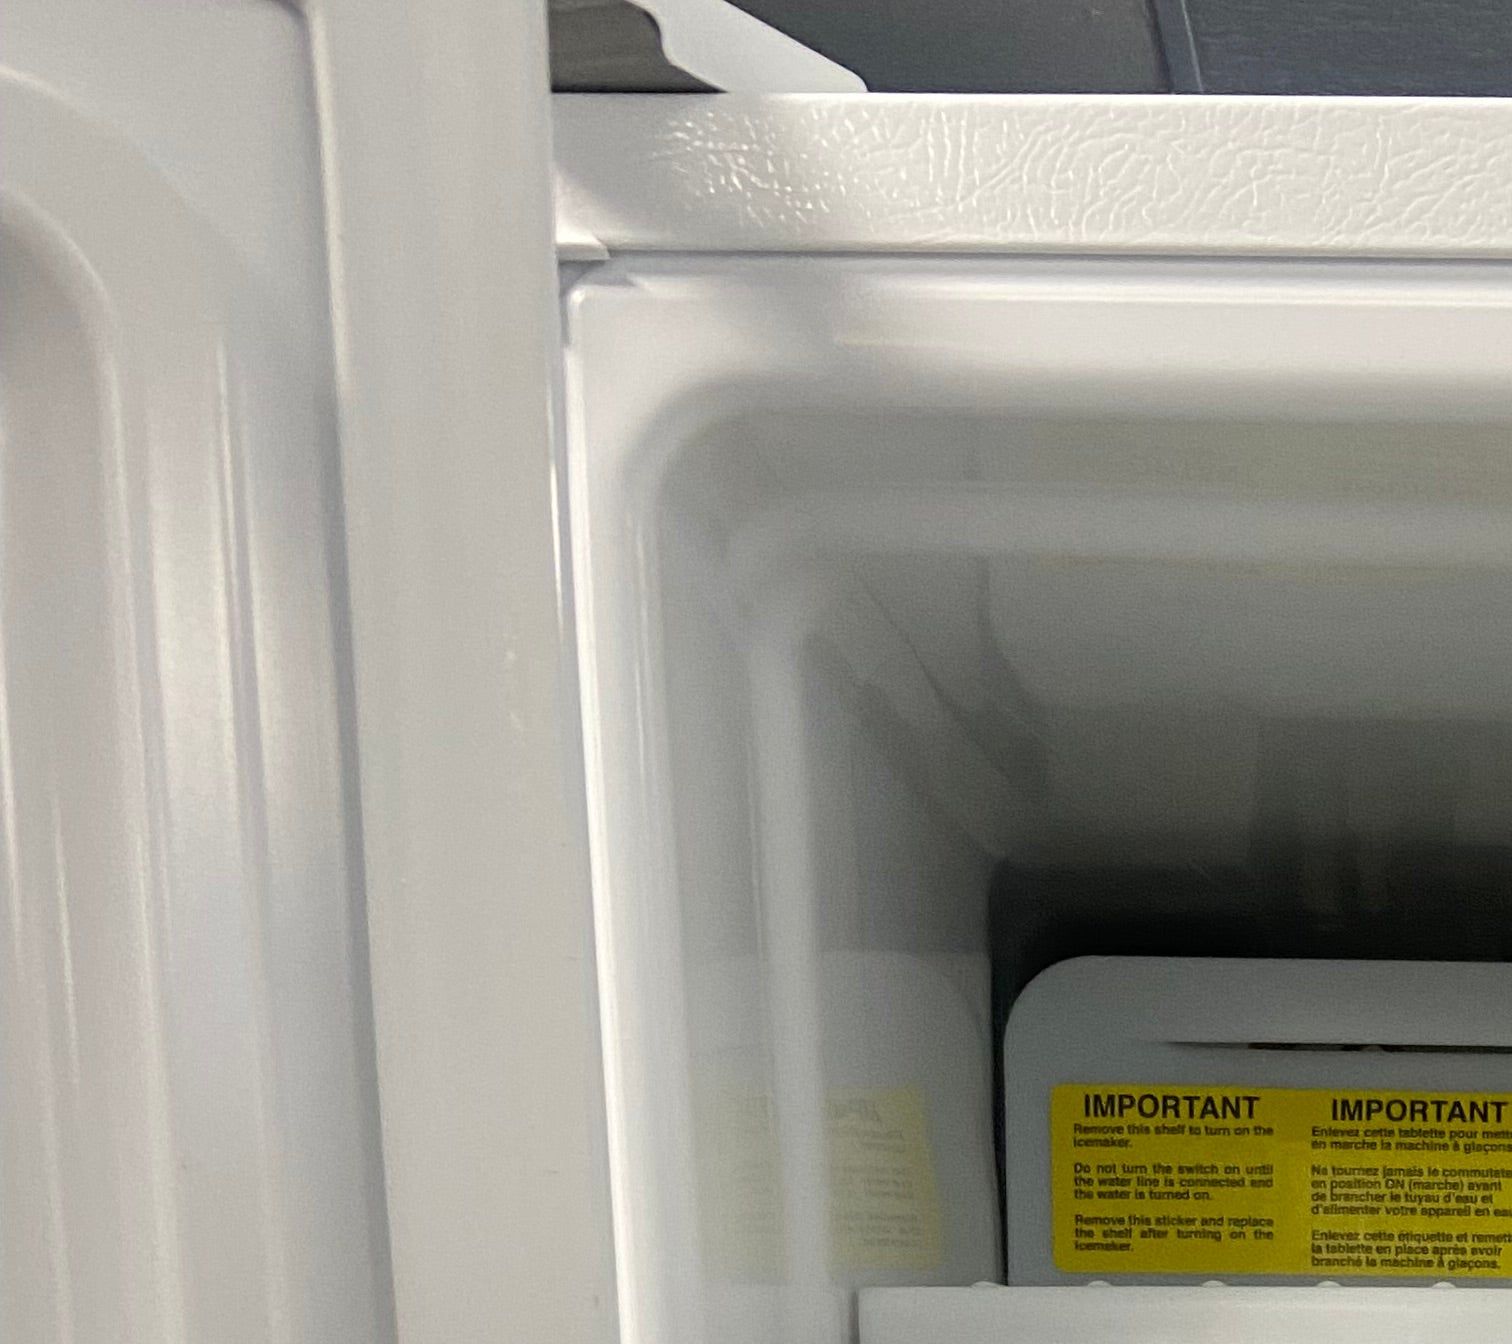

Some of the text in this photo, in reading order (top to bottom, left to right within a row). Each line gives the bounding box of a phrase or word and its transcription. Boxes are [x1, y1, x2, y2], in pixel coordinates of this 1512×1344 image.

[1084, 1094, 1260, 1119] IMPORTANT
[1332, 1099, 1508, 1123] IMPORTANT
[1073, 1123, 1274, 1136] Remove this shelf to turn on the
[1311, 1127, 1359, 1137] Enlevez
[1364, 1128, 1395, 1137] cette
[1398, 1128, 1445, 1138] tablette
[1449, 1130, 1477, 1140] pour
[1330, 1140, 1377, 1150] marche
[1380, 1141, 1392, 1150] la
[1395, 1141, 1449, 1151] machine
[1074, 1163, 1273, 1175] Do not turn the switch on until
[1331, 1166, 1379, 1176] tournez
[1382, 1166, 1424, 1179] jamais
[1427, 1167, 1439, 1177] le
[1074, 1176, 1273, 1187] the water line is connected and
[1311, 1179, 1502, 1192] en position ON (marche) avant
[1074, 1189, 1094, 1199] the
[1096, 1189, 1131, 1200] water
[1134, 1190, 1145, 1200] is
[1148, 1190, 1190, 1200] turned
[1311, 1192, 1327, 1201] de
[1330, 1192, 1386, 1202] brancher
[1389, 1193, 1401, 1202] le
[1404, 1193, 1440, 1205] tuyau
[1481, 1194, 1493, 1203] et
[1385, 1205, 1417, 1215] votre
[1420, 1206, 1471, 1218] appareil
[1474, 1208, 1490, 1216] en
[1075, 1215, 1274, 1229] Remove this sticker and replace
[1075, 1228, 1274, 1241] the shelf after turning on the
[1311, 1231, 1360, 1241] Enlevez
[1364, 1231, 1395, 1241] cette
[1455, 1232, 1468, 1242] et
[1311, 1244, 1322, 1253] la
[1325, 1244, 1373, 1254] tablette
[1375, 1246, 1391, 1254] en
[1395, 1245, 1429, 1257] place
[1471, 1246, 1502, 1255] avoir
[1365, 1257, 1377, 1267] la
[1380, 1257, 1434, 1268] machine
